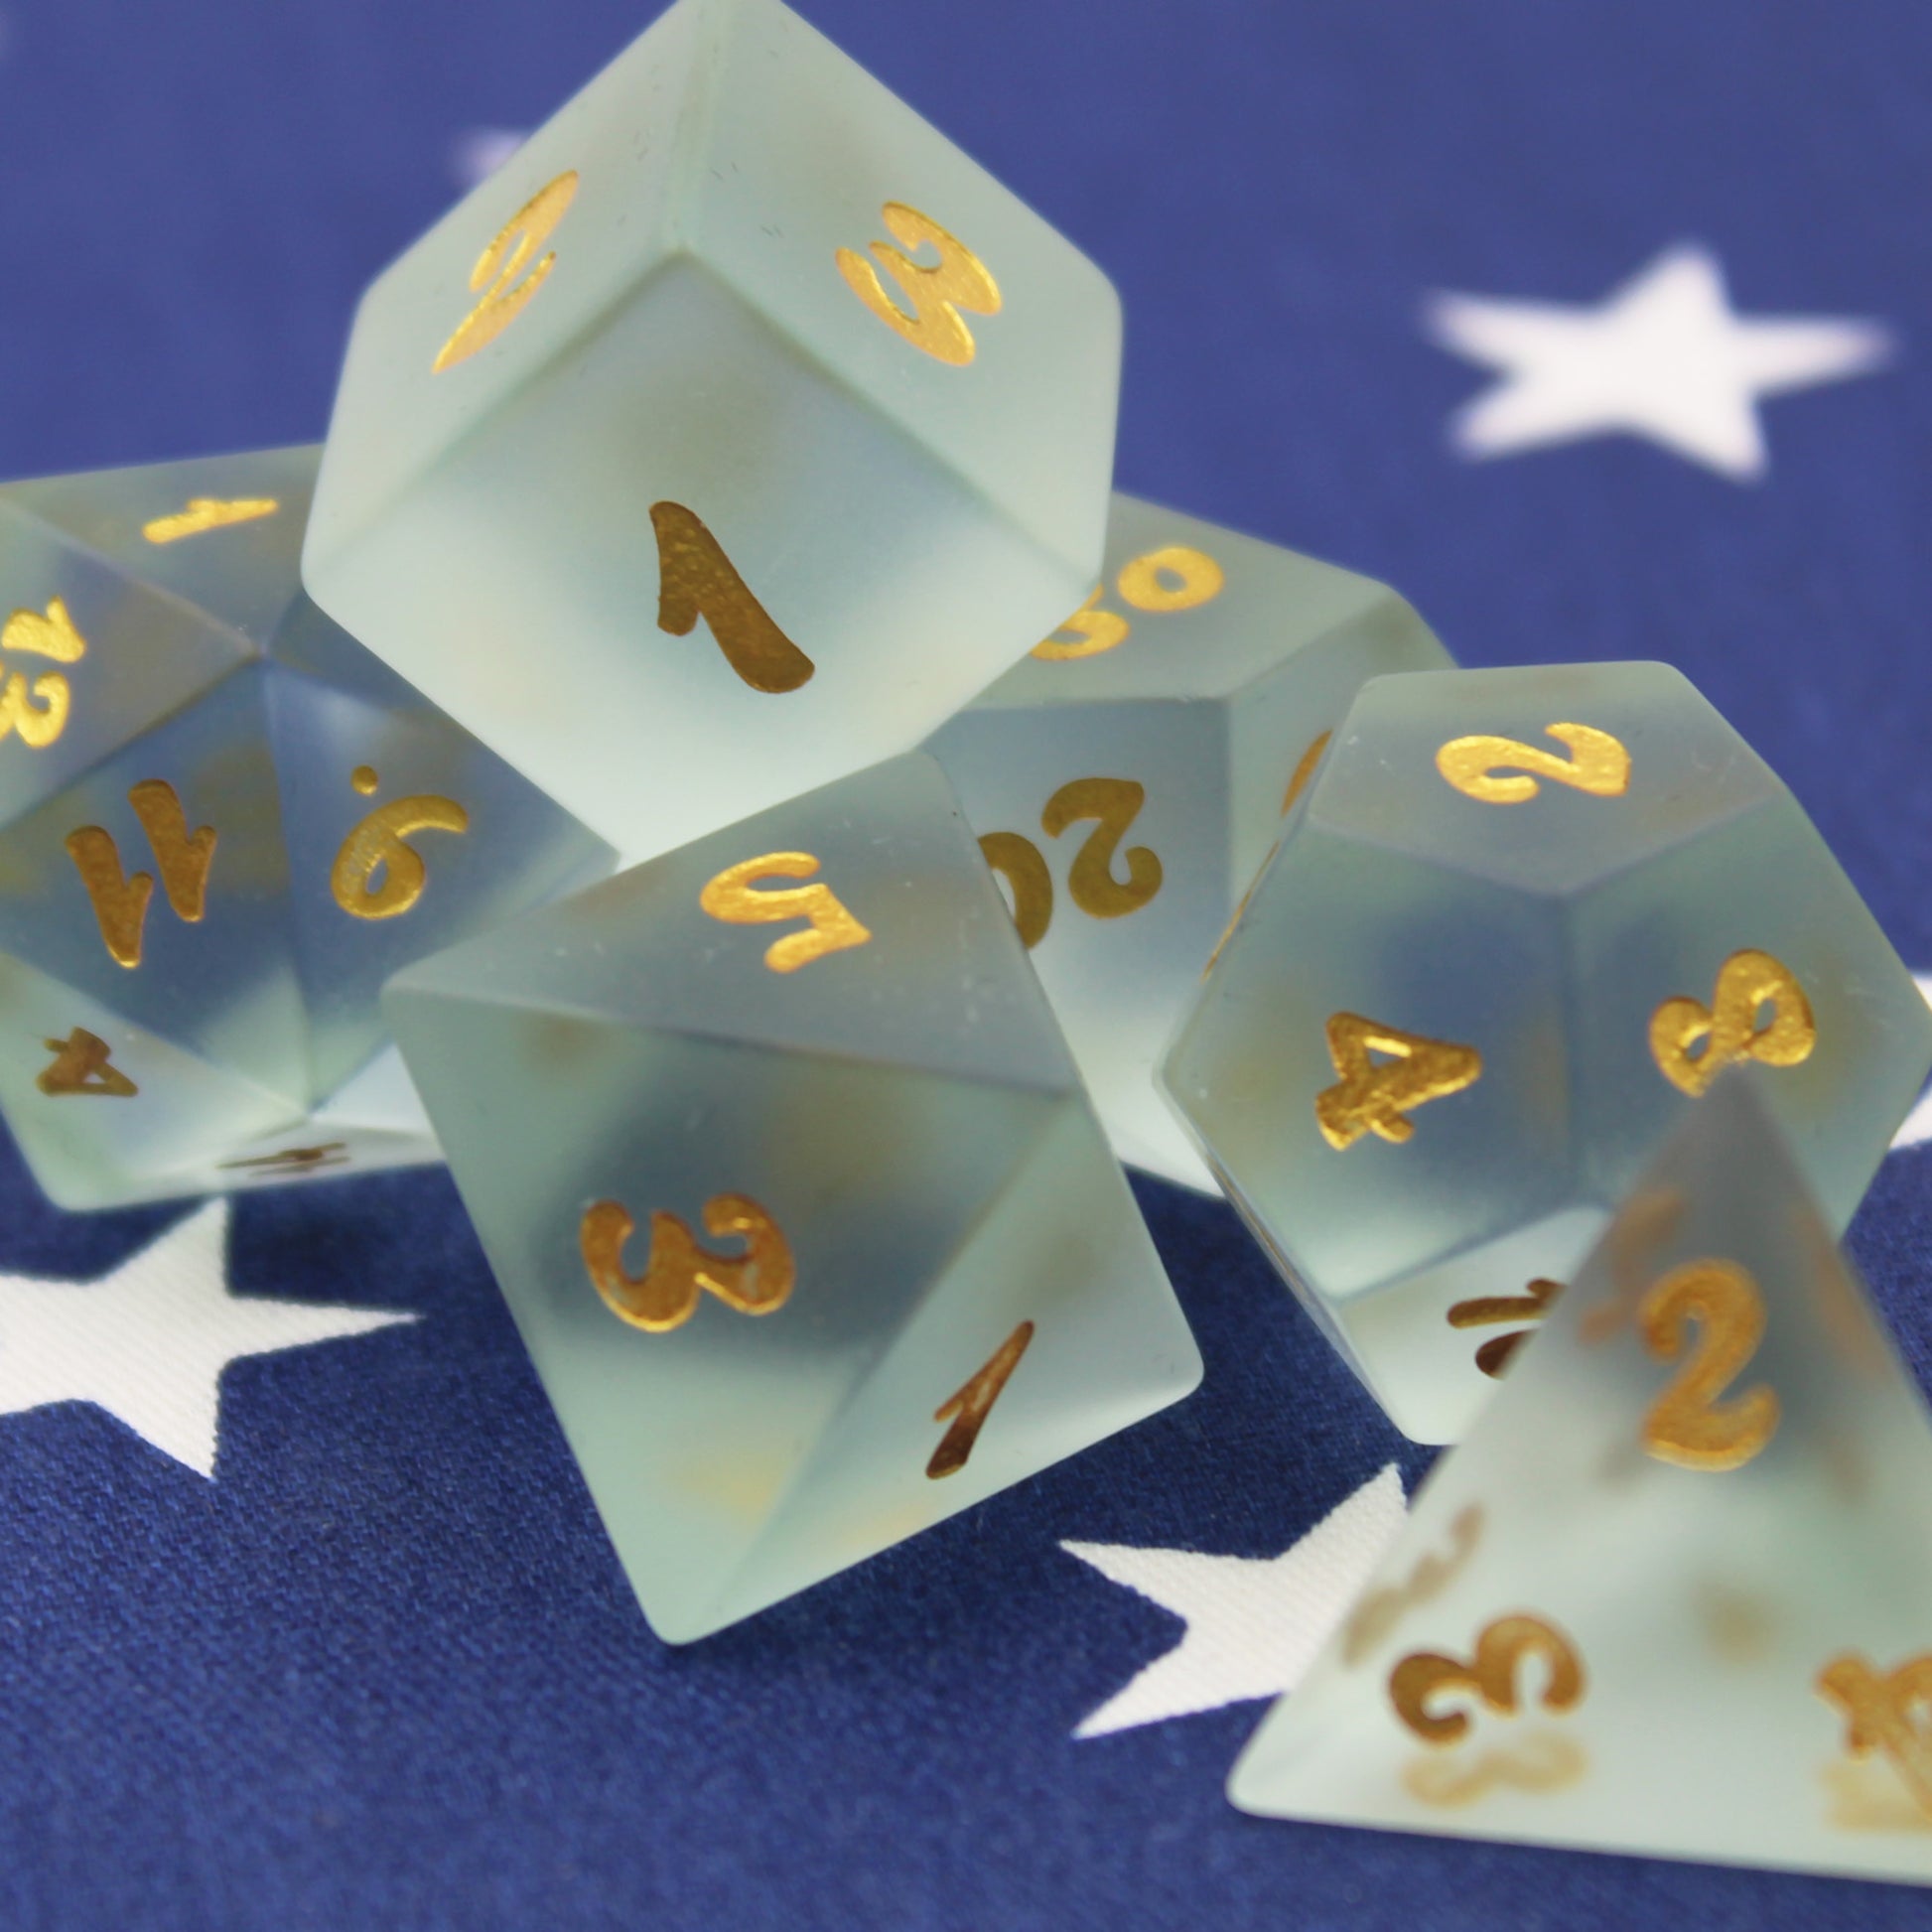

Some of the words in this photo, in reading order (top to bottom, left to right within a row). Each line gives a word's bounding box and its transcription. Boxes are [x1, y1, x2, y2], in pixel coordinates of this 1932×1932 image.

[432, 168, 579, 375] 2
[835, 201, 1002, 367] 3
[141, 496, 280, 544] 1
[647, 499, 816, 694] 1
[1436, 722, 1632, 804] 2
[65, 778, 217, 969] 11
[700, 851, 872, 973] 5
[36, 1026, 138, 1098] 4
[1314, 1011, 1482, 1152] 4
[1648, 948, 1816, 1099] 8
[579, 1192, 794, 1333] 3
[924, 1318, 1035, 1480] 1
[1638, 1257, 1781, 1473] 2
[1388, 1613, 1587, 1749] 3
